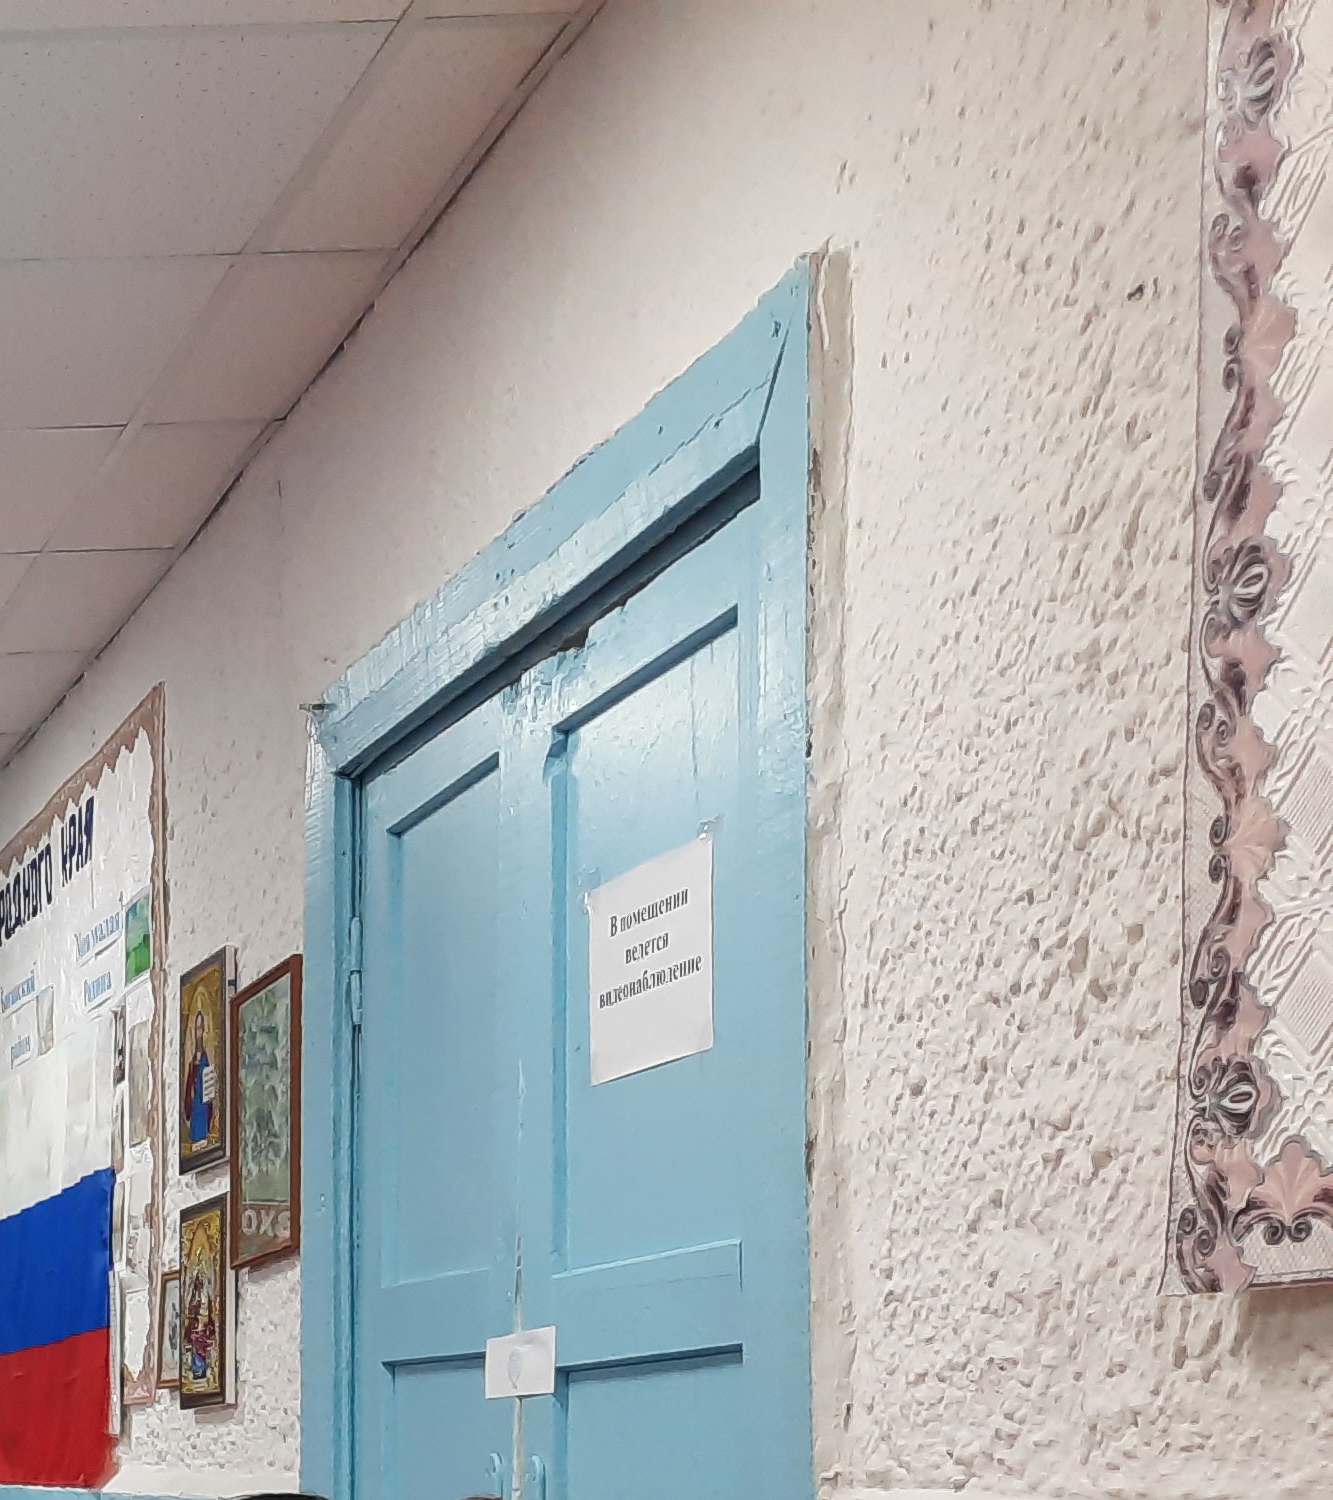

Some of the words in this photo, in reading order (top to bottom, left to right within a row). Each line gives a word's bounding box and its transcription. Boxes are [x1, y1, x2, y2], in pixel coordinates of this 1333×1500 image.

[61, 795, 95, 887] КРАЯ
[609, 914, 619, 937] В
[620, 888, 689, 932] помещении
[599, 954, 702, 1009] видеонаблюдение
